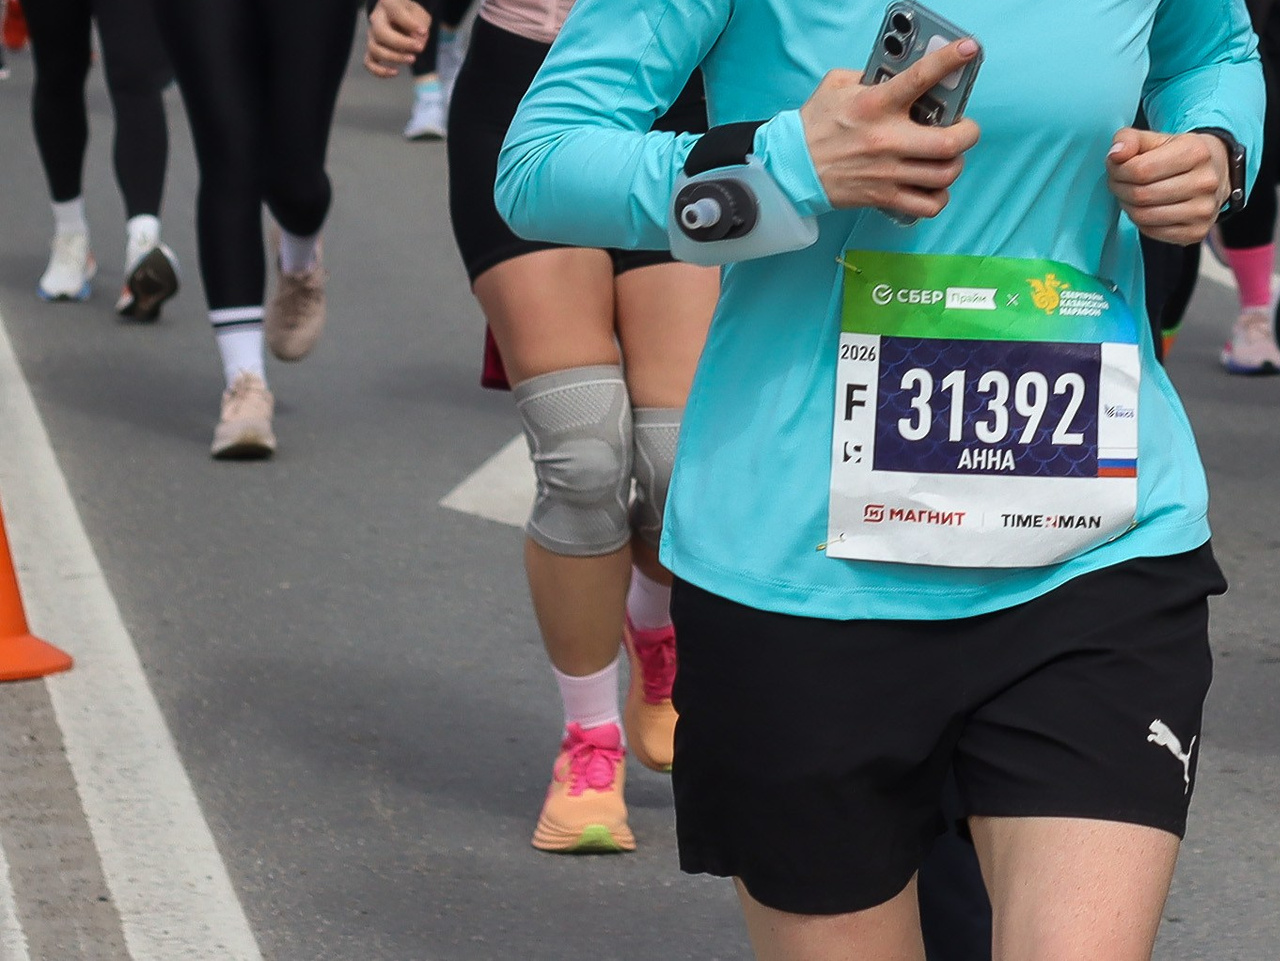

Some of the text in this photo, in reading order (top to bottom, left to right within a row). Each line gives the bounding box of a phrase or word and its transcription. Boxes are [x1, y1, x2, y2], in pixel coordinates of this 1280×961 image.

[896, 289, 943, 305] СБЕР
[841, 344, 876, 361] 2026
[844, 383, 868, 420] F
[897, 367, 1085, 445] 31392
[957, 448, 1016, 471] АННА
[889, 508, 966, 527] МАГНИТ
